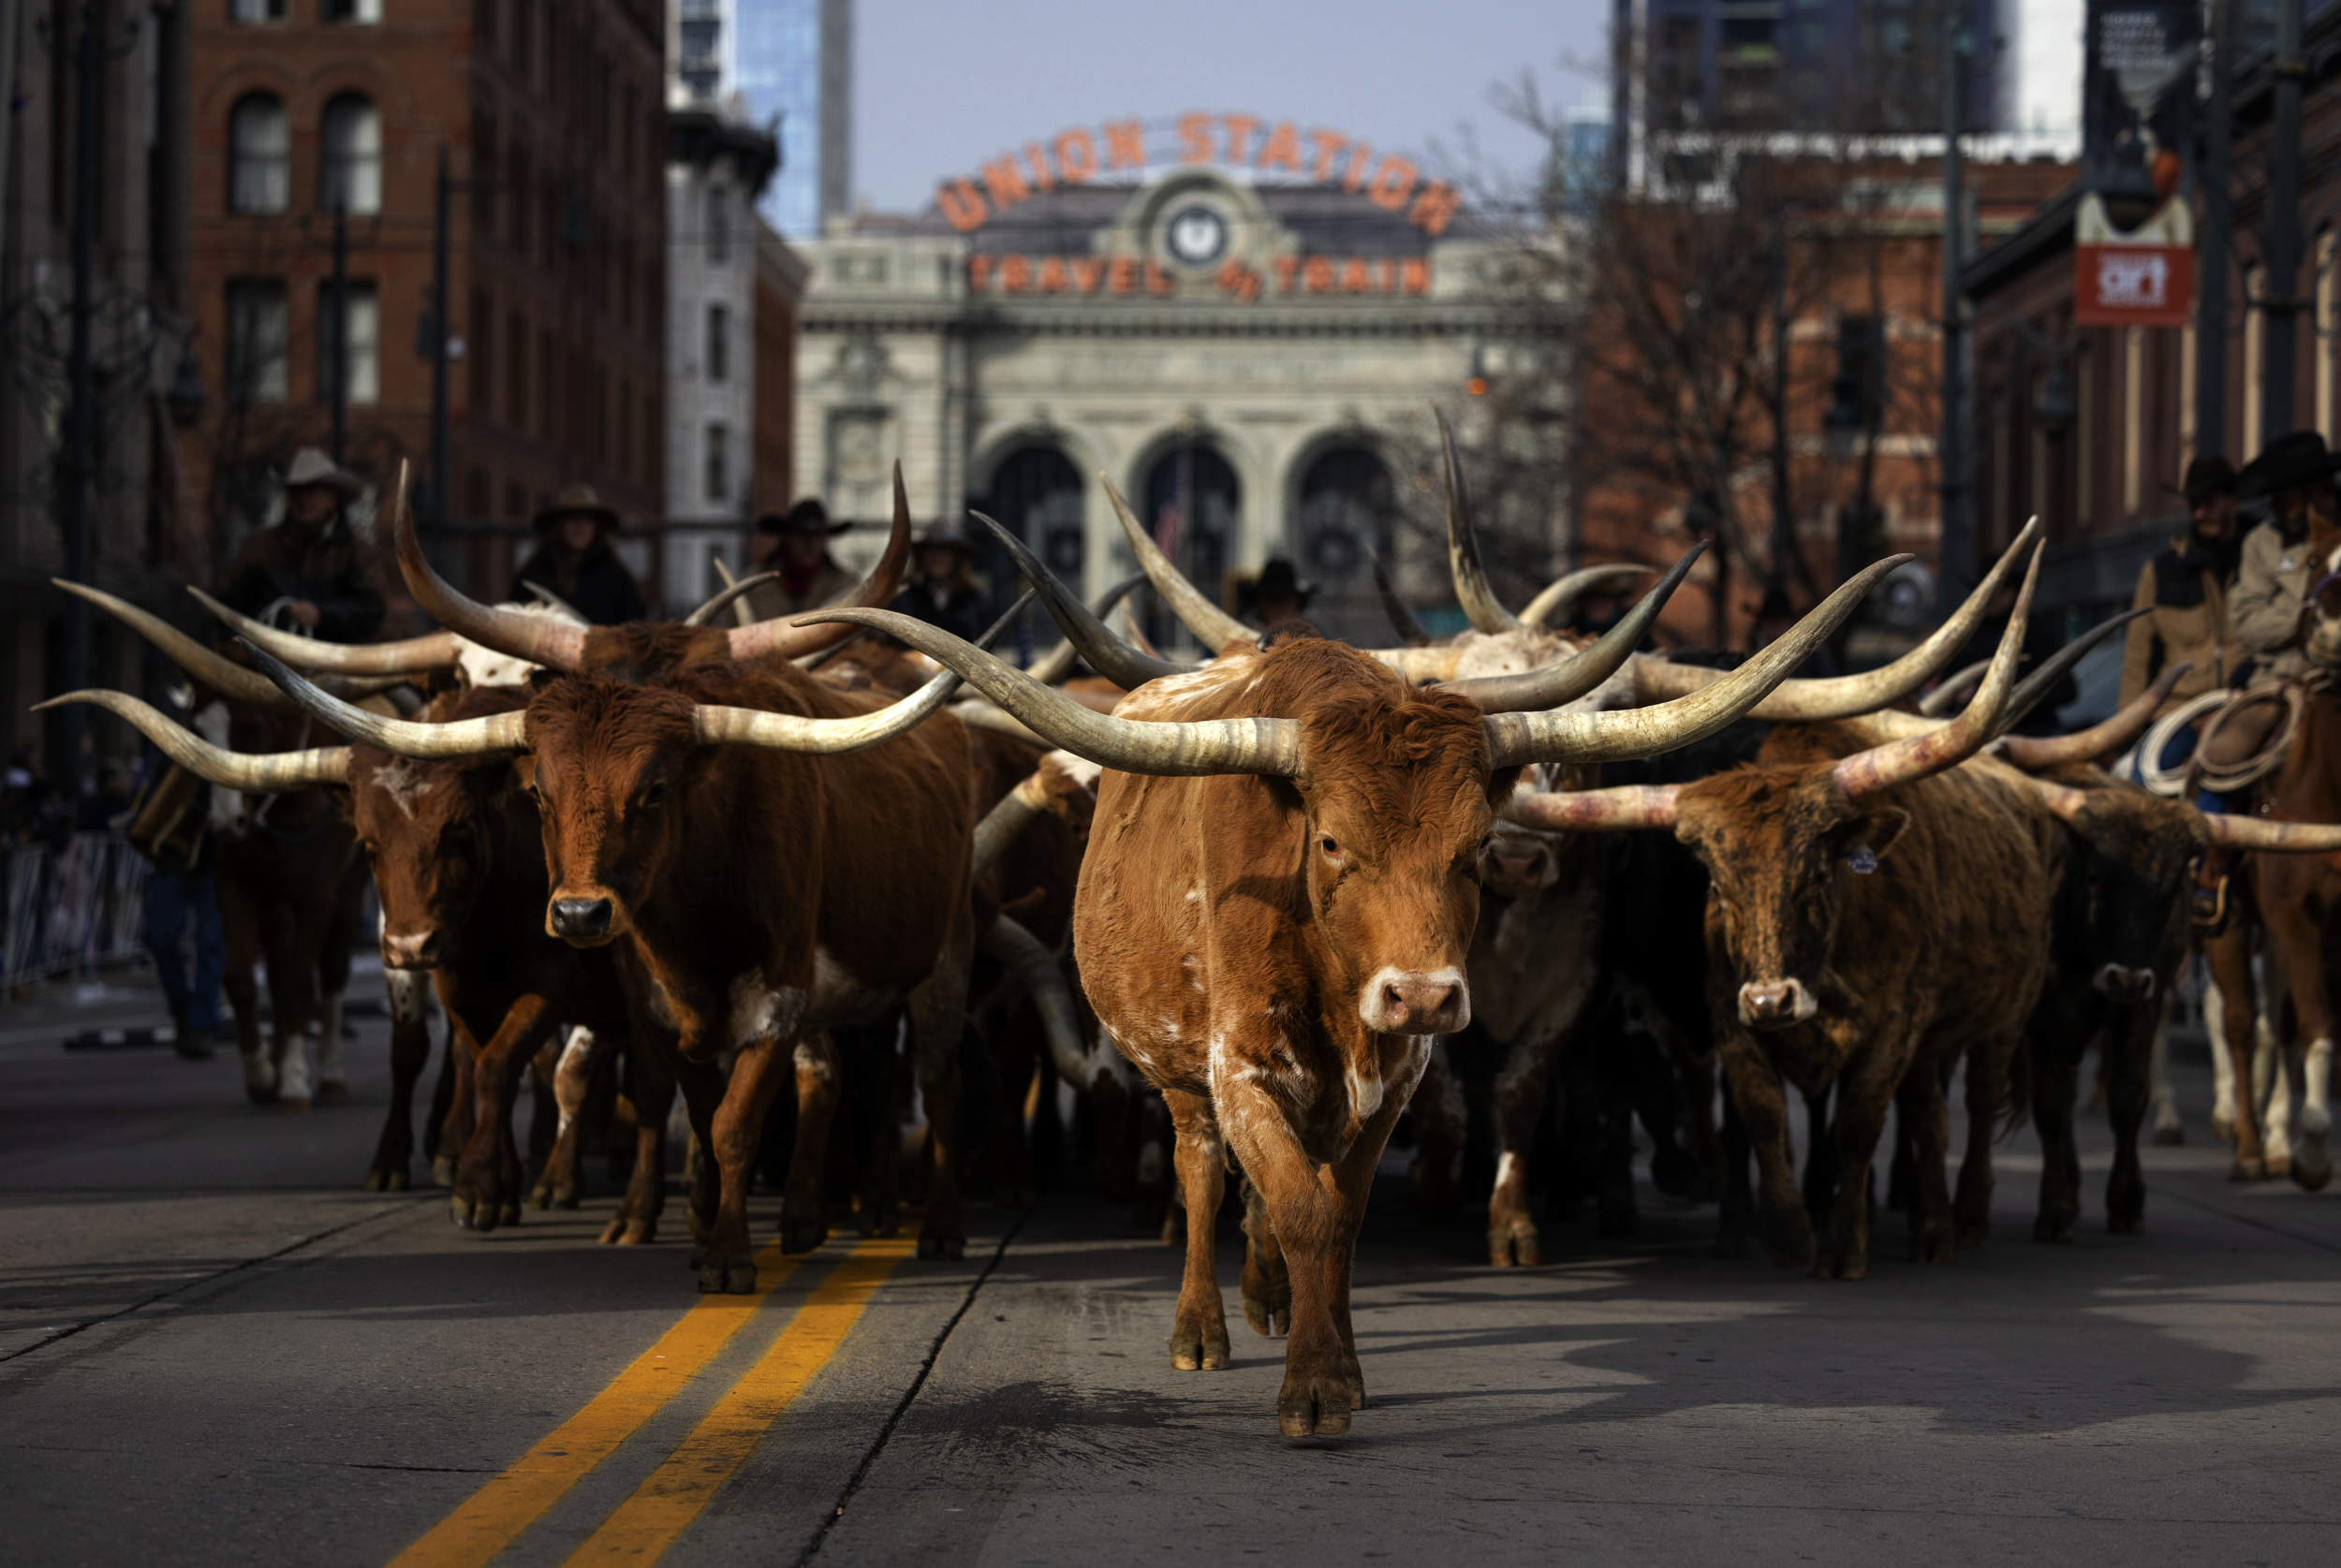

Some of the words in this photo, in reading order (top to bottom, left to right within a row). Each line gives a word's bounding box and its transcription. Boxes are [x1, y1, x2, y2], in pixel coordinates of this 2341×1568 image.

[937, 114, 1146, 232] UNION
[1177, 110, 1462, 237] STATION
[968, 255, 1173, 296] TRAVEL
[1274, 255, 1432, 296] TRAIN
